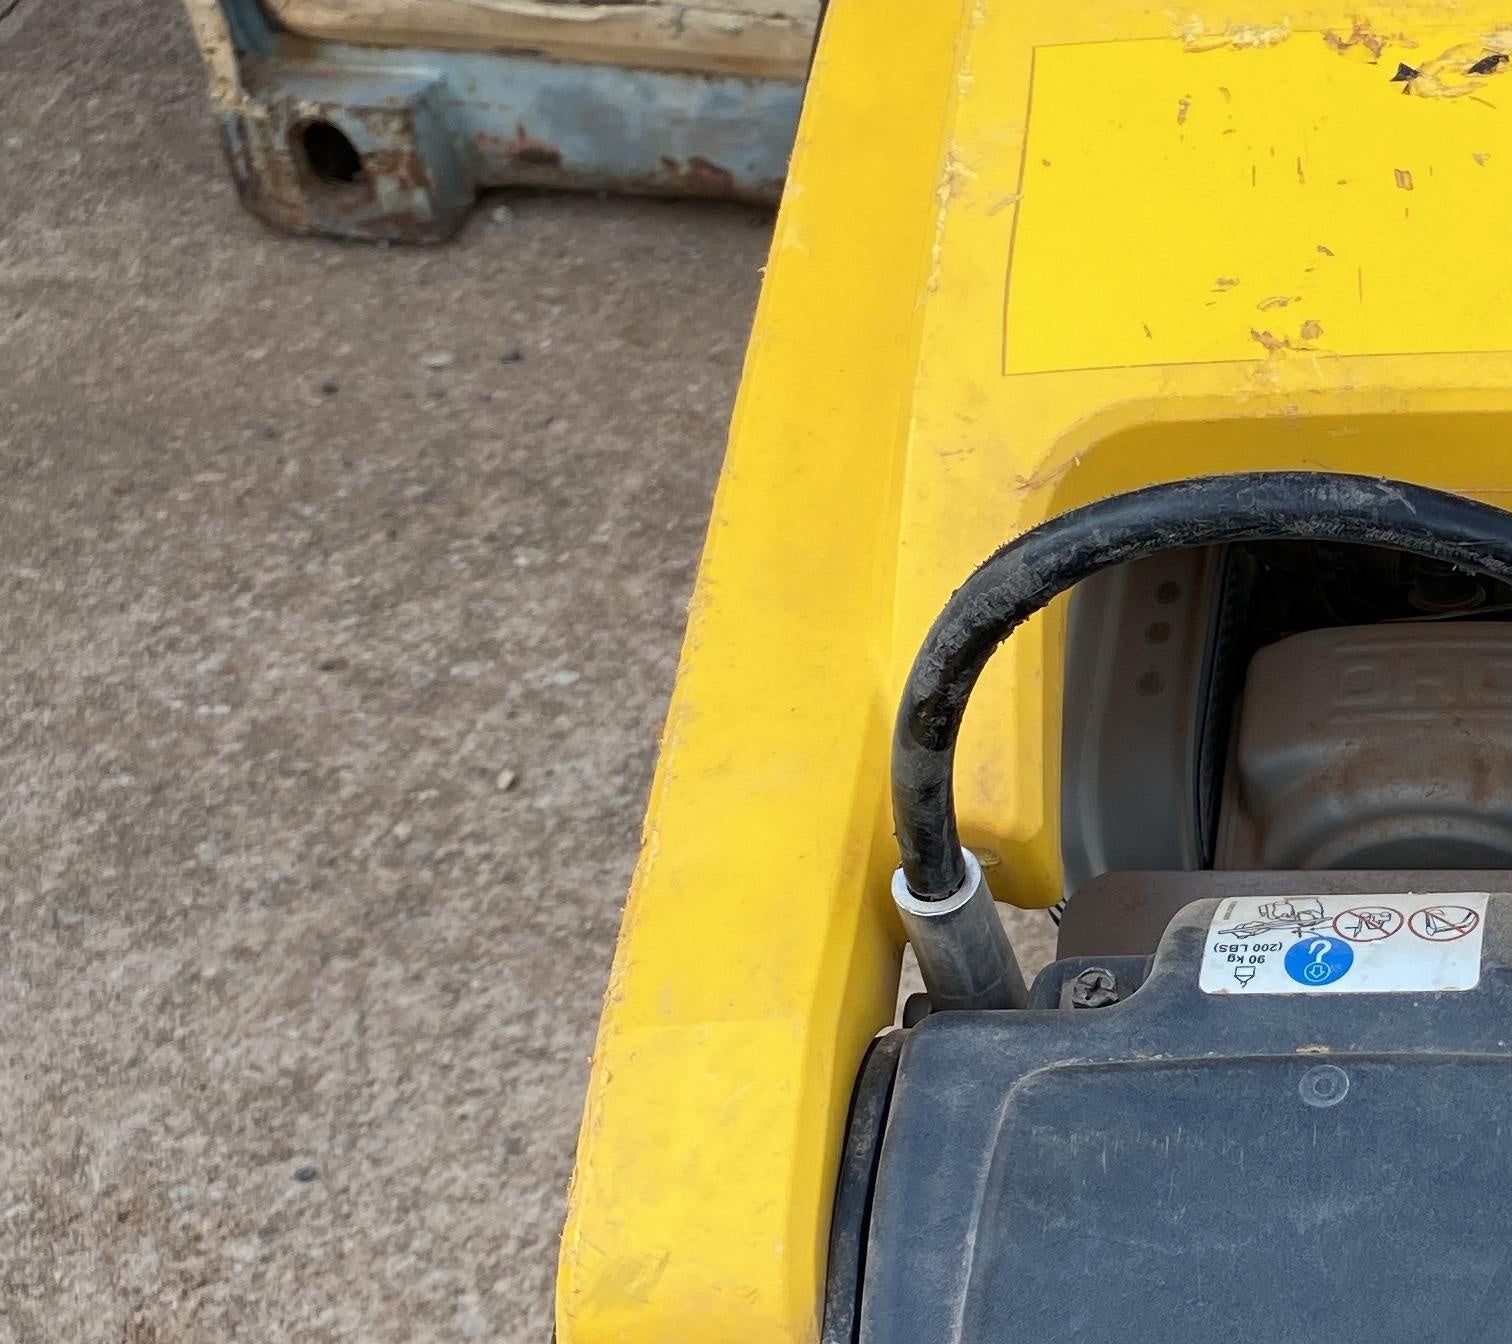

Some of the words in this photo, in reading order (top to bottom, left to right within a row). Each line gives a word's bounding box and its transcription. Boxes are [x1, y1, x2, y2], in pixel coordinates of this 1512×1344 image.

[1213, 942, 1248, 953] LBS)
[1252, 941, 1283, 953] (200
[1227, 953, 1244, 964] kg
[1249, 954, 1266, 964] 90
